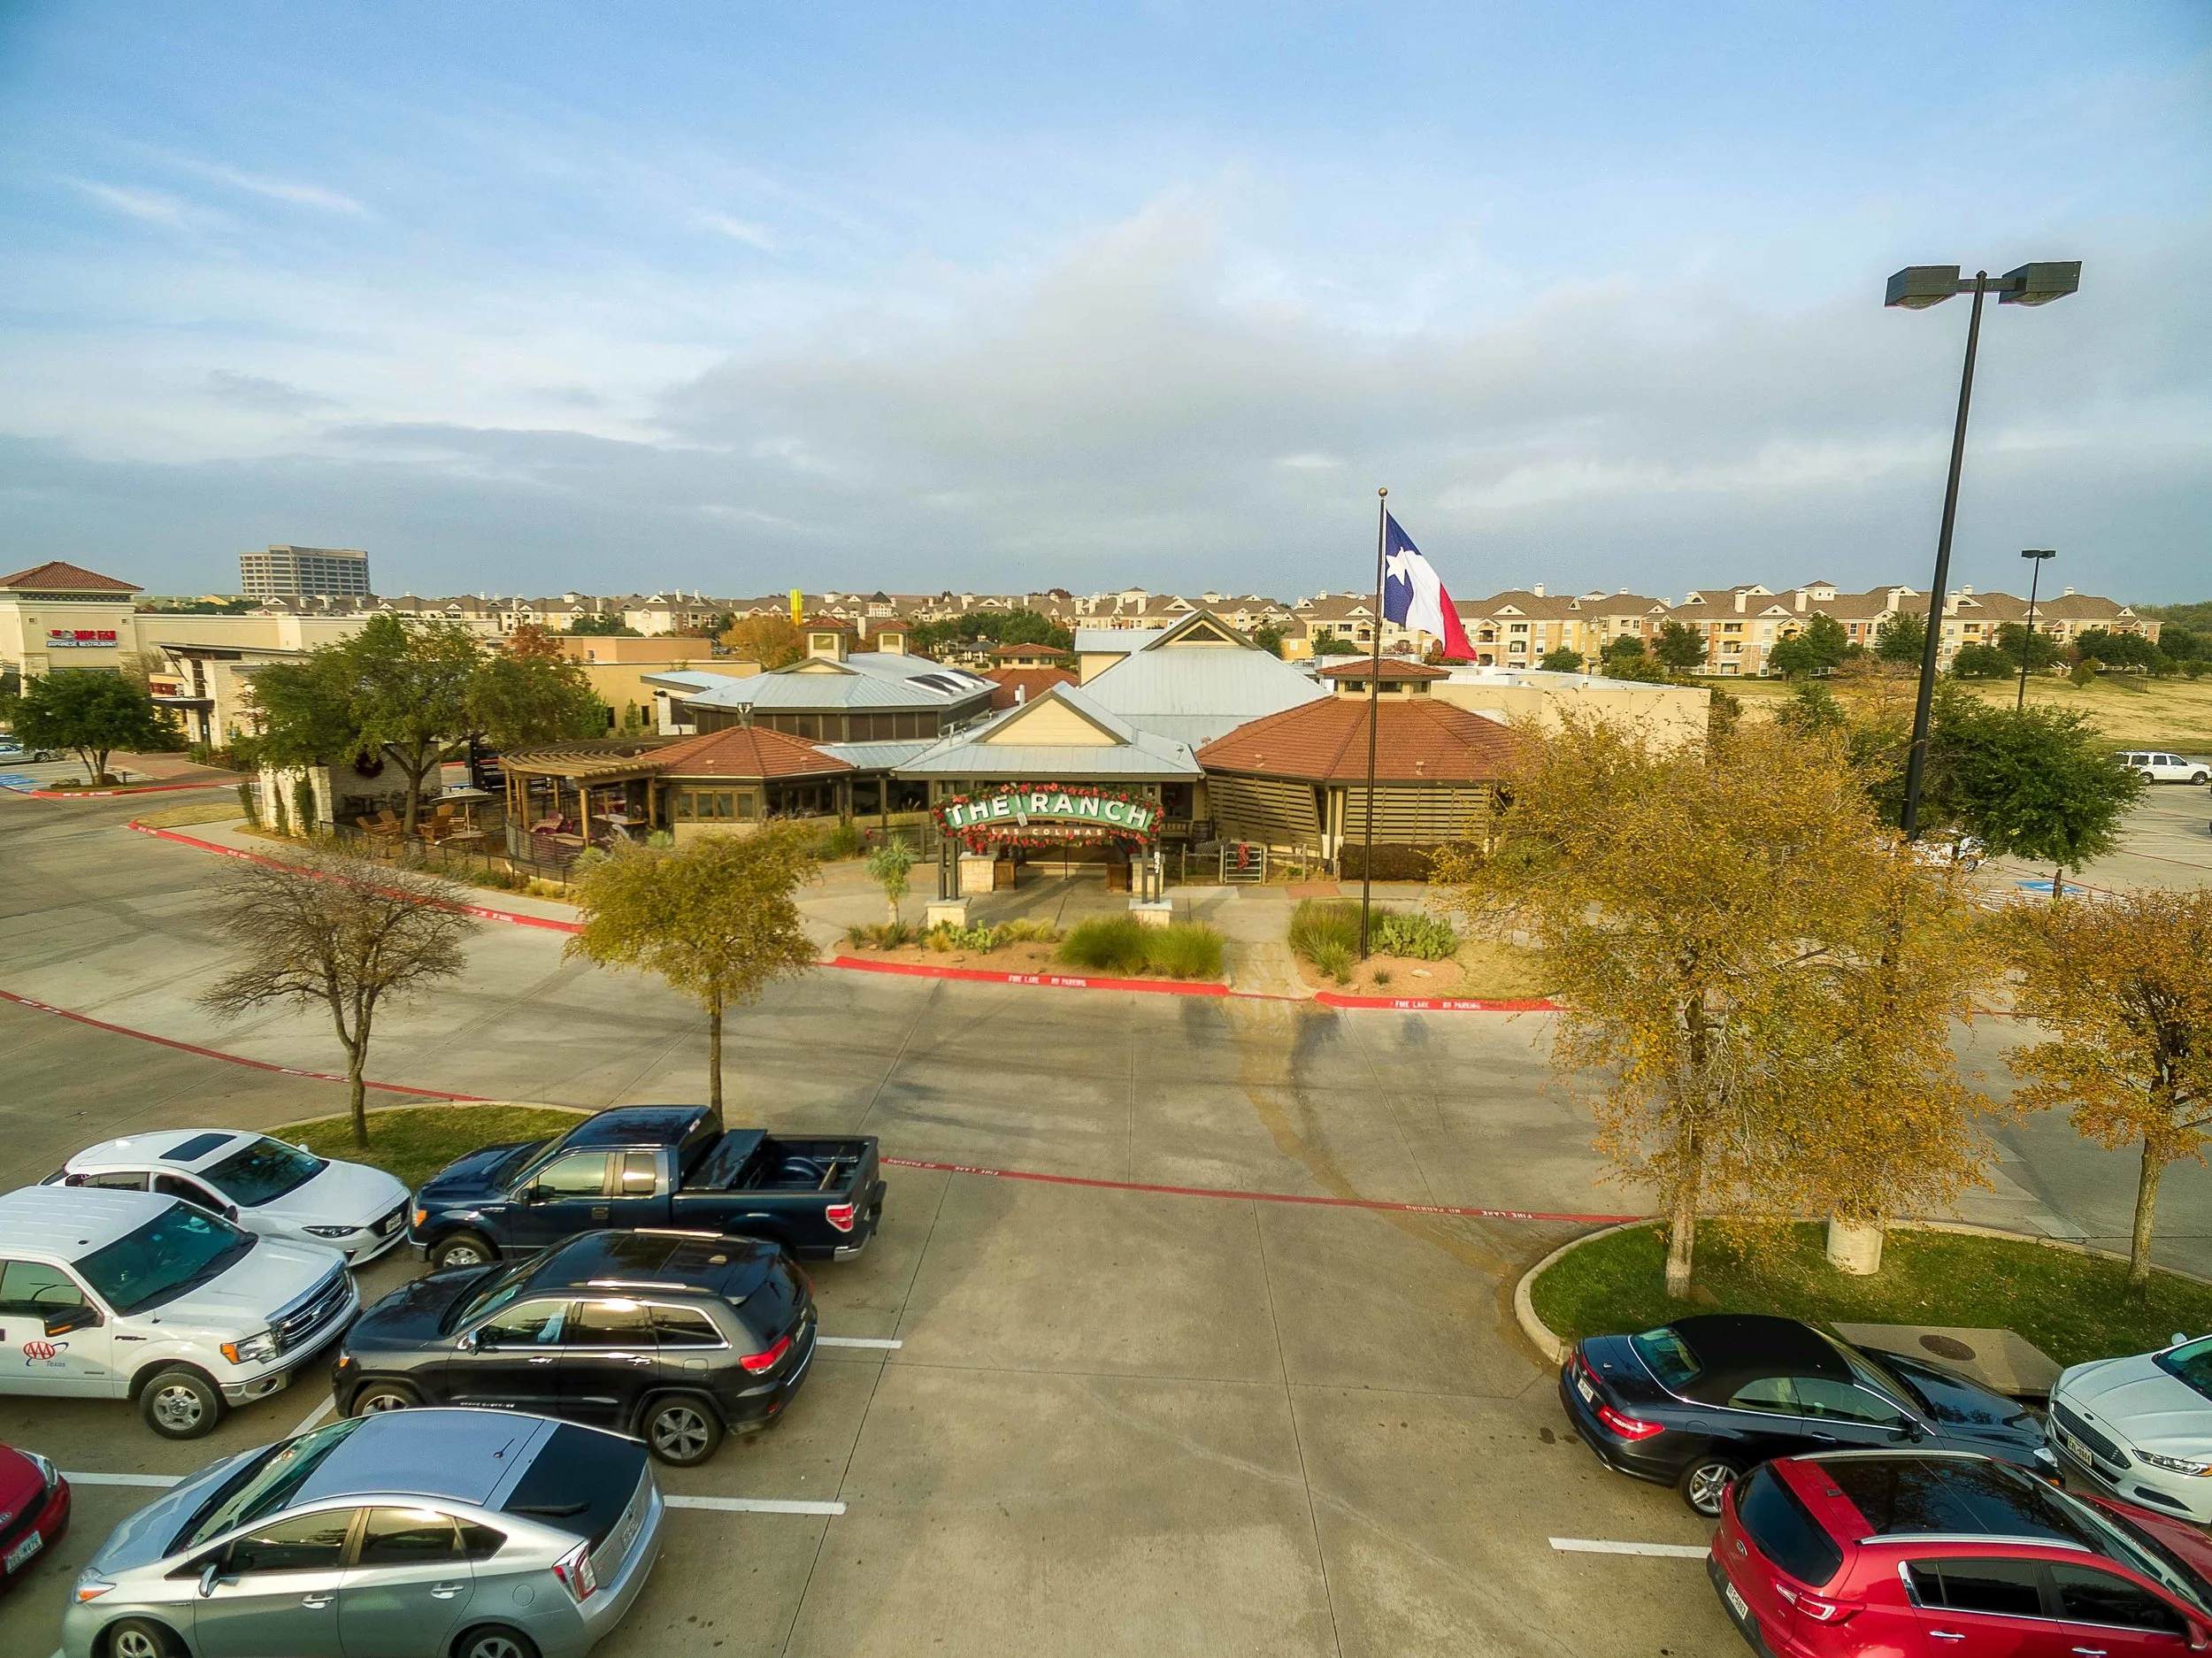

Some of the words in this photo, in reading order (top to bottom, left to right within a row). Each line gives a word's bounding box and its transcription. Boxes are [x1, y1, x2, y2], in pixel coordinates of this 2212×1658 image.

[946, 794, 1010, 825] THE
[1030, 792, 1148, 828] RANCH
[991, 827, 1019, 836] LAS
[1032, 827, 1102, 836] COLINAS
[1009, 975, 1022, 984] FIRE
[1024, 976, 1040, 985] LANE
[1061, 979, 1087, 987] PARKING
[1394, 1000, 1409, 1009] FIRE
[27, 1340, 54, 1360] AAA
